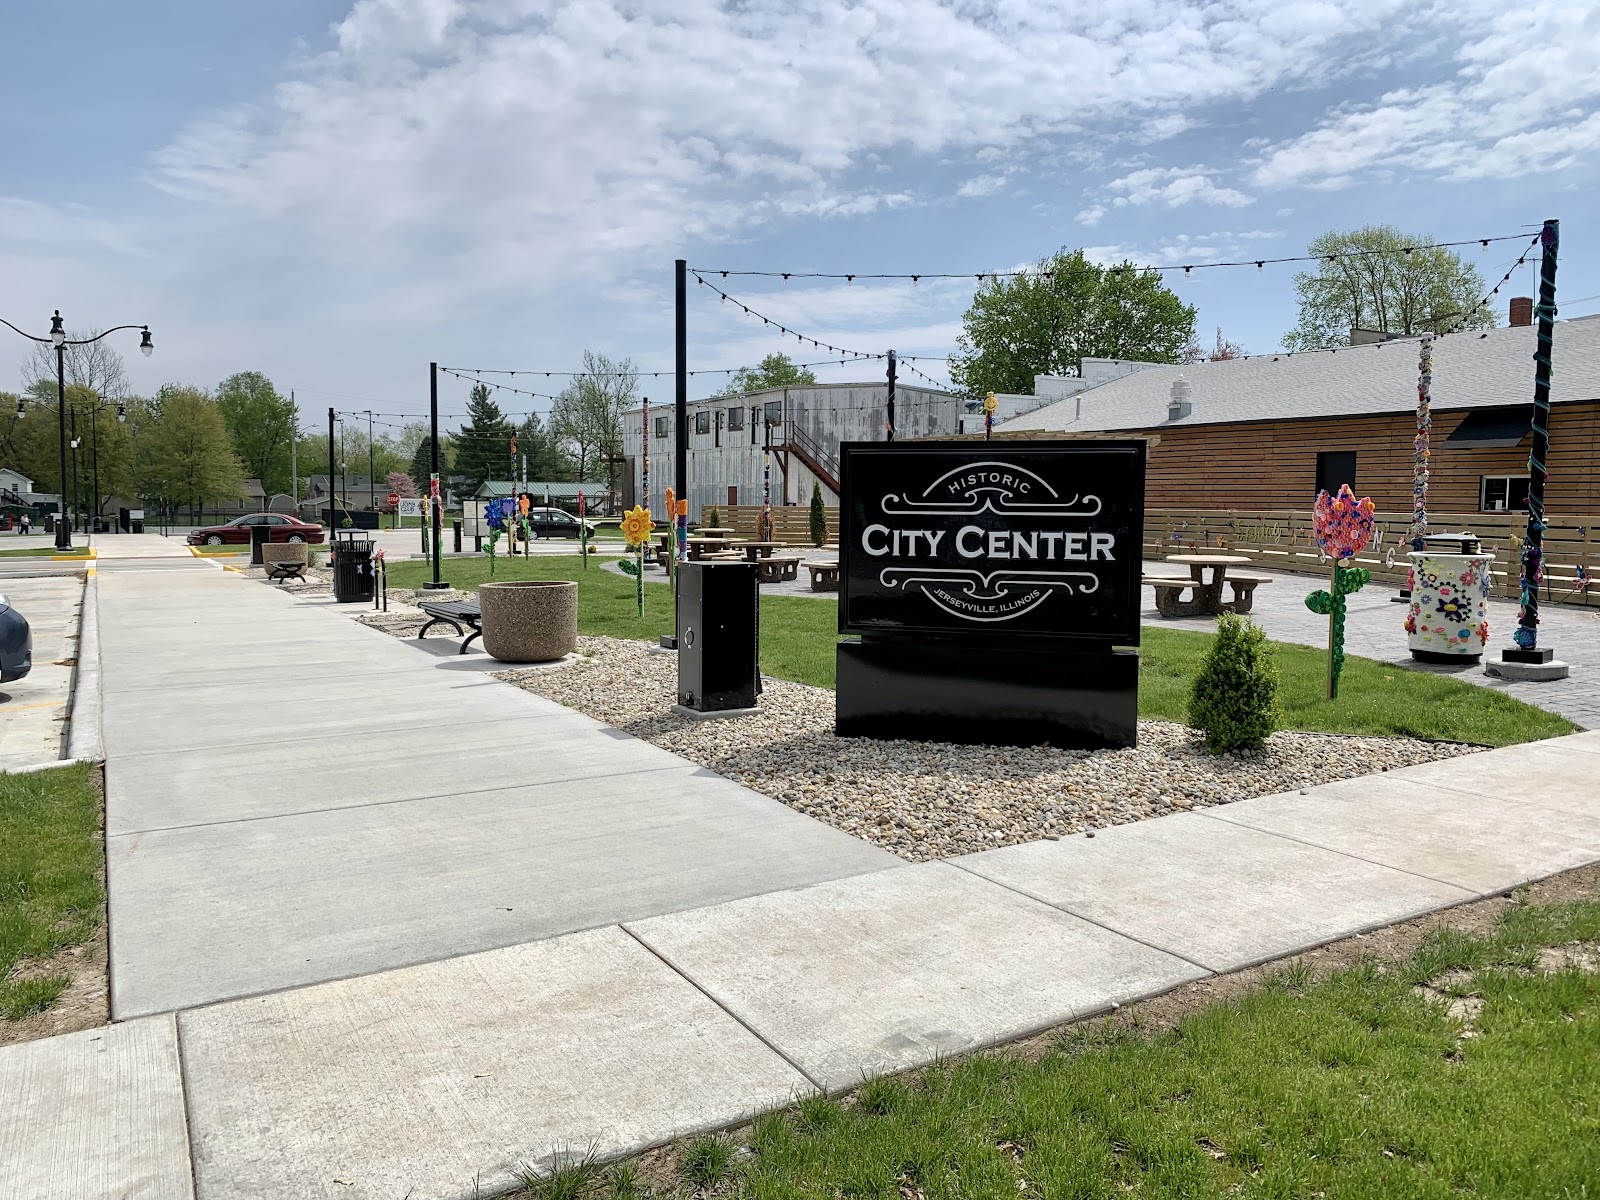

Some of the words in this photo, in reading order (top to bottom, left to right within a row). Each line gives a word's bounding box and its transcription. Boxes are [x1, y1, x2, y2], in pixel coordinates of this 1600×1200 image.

[948, 472, 1031, 494] HISTORIC
[861, 523, 946, 557] CITY
[955, 525, 1116, 562] CENTER
[933, 587, 998, 613] JERSEYVILLE,
[1000, 589, 1040, 612] ILLINOIS
